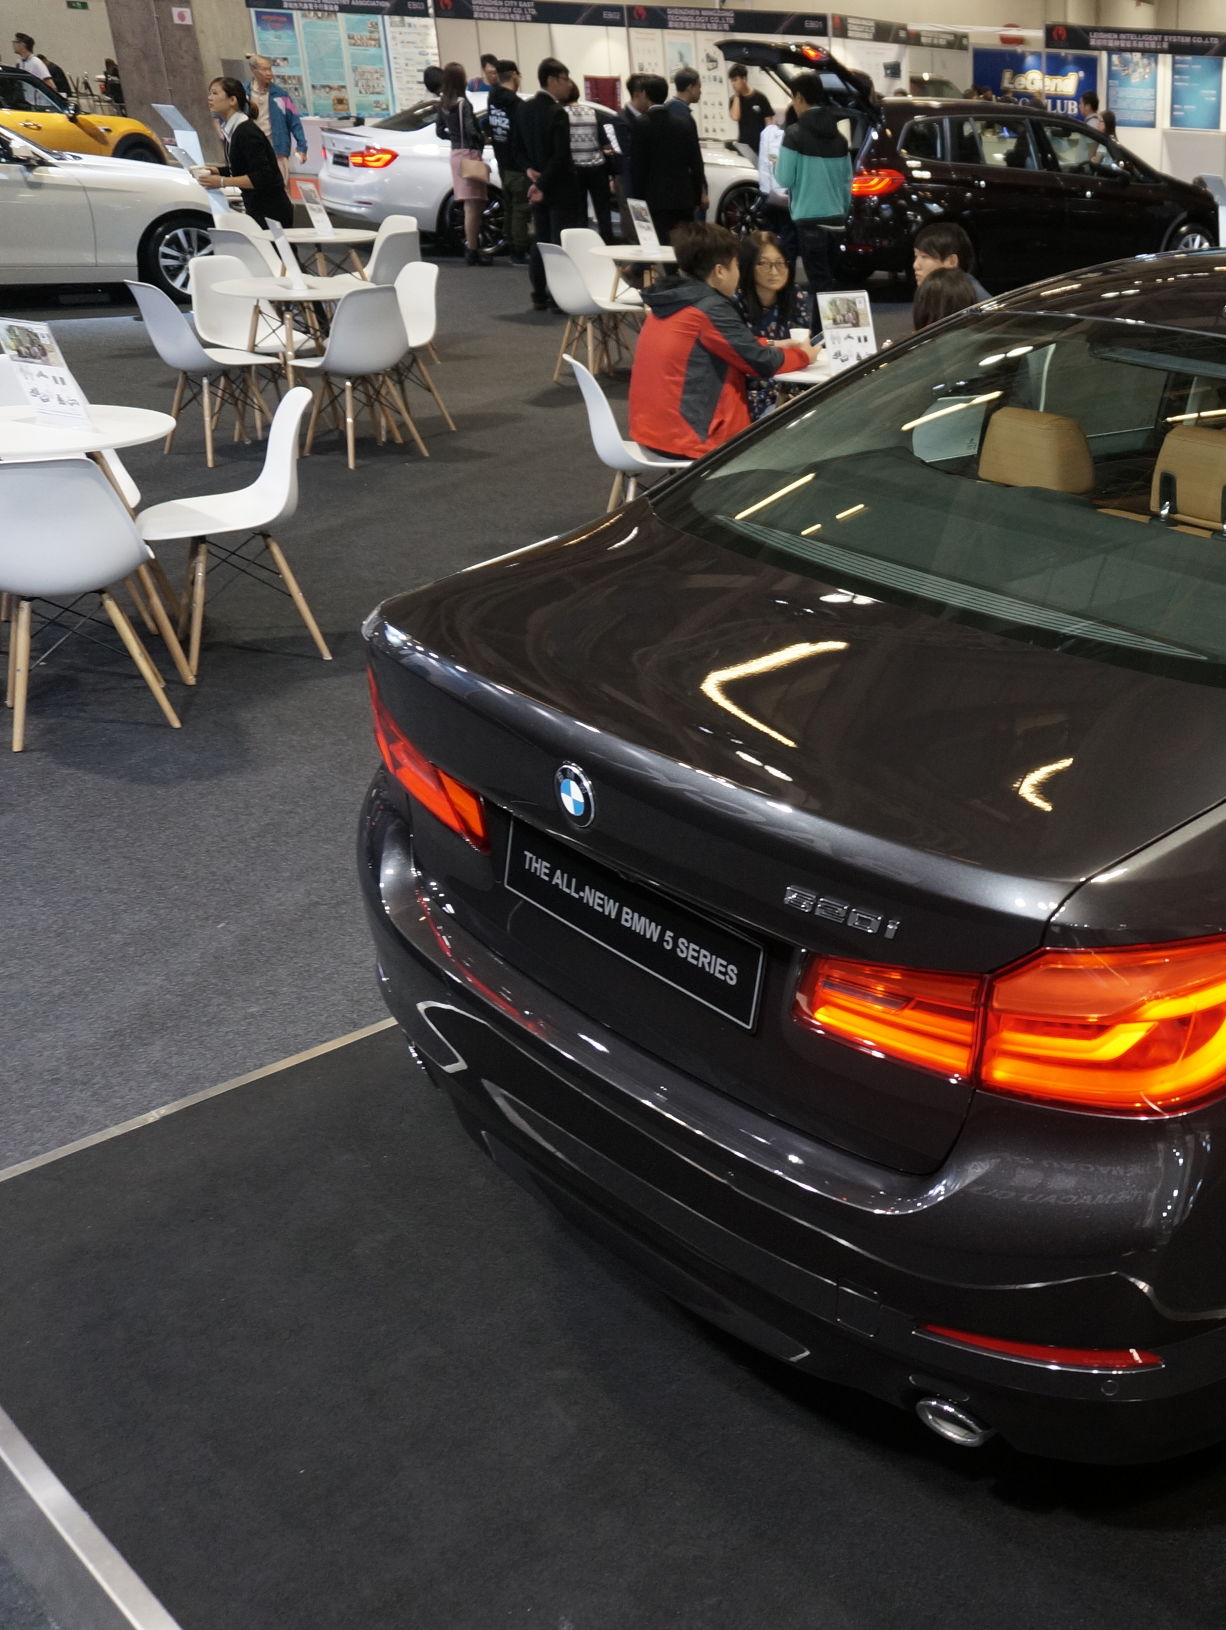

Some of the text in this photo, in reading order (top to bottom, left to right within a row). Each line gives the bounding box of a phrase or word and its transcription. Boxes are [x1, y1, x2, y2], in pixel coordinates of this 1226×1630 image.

[1119, 33, 1162, 42] INTELLIGENT
[1164, 35, 1191, 43] SYSTEM
[524, 850, 738, 985] THE ALL-NEW BMW 5 SERIES
